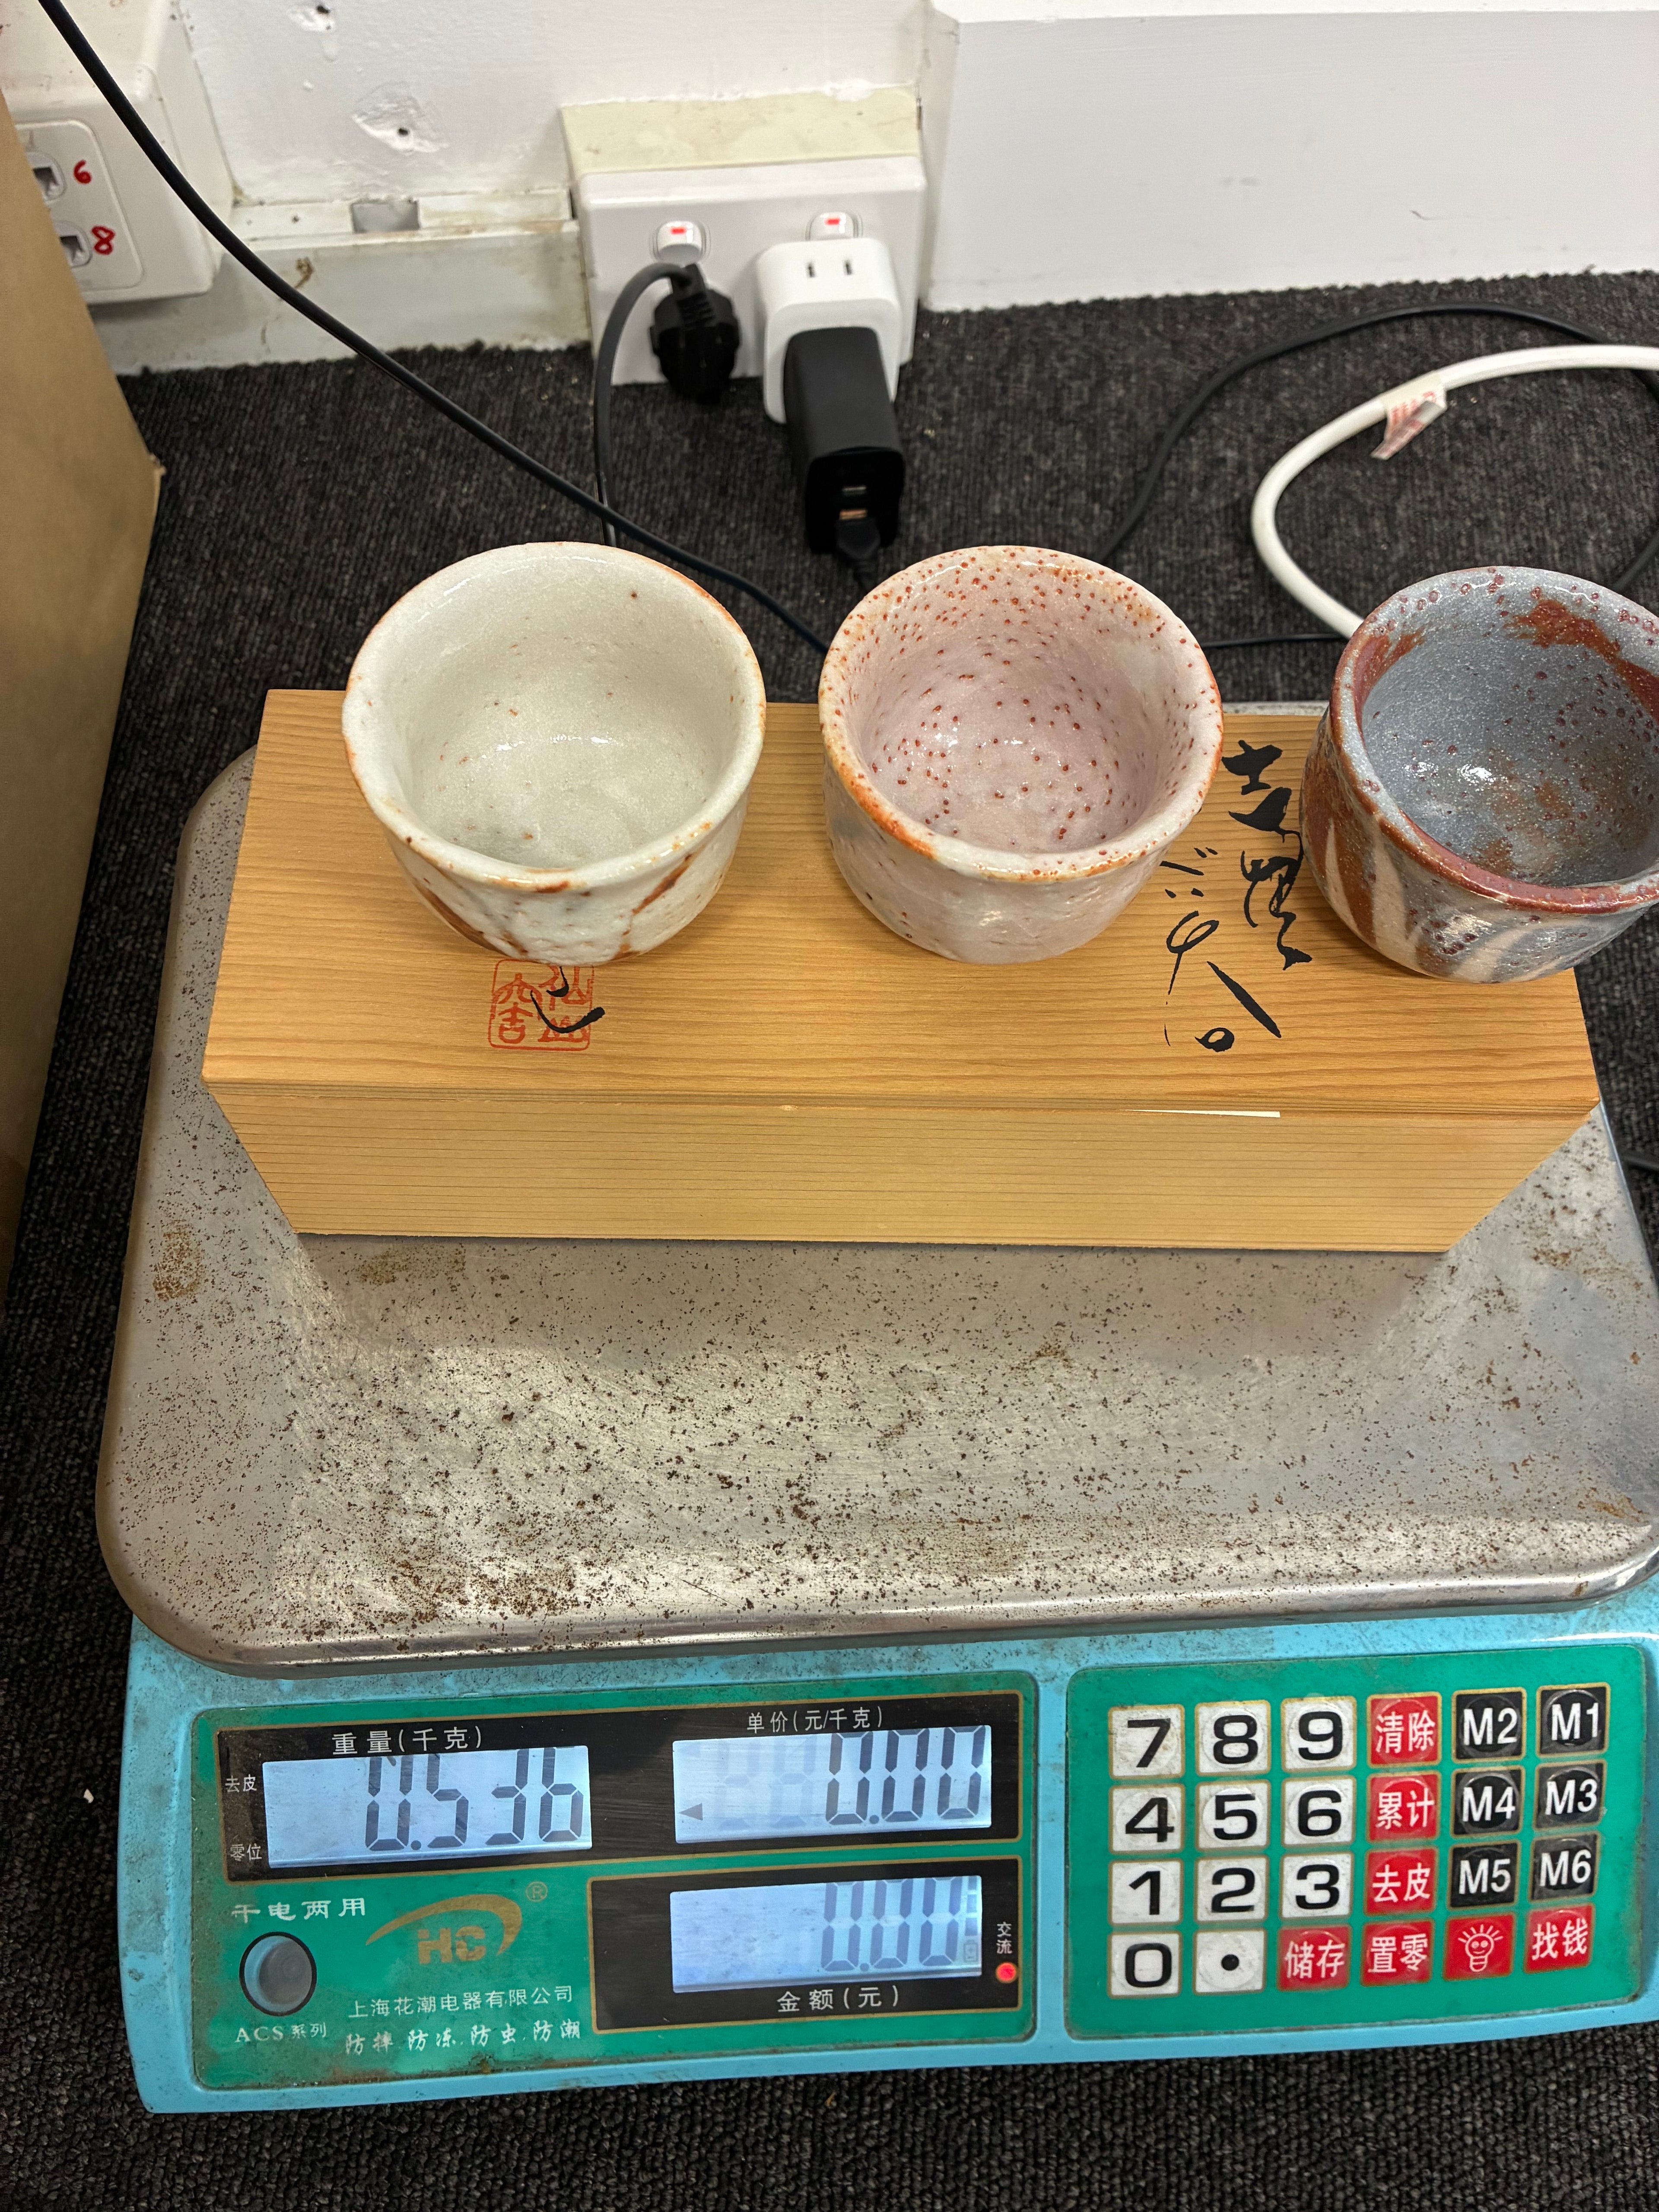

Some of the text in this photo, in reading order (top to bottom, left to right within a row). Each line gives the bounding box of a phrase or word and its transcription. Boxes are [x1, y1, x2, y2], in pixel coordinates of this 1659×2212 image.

[73, 159, 92, 184] 6
[91, 225, 116, 255] 8
[747, 1706, 883, 1734] 单价(元/千克)
[1213, 1715, 1258, 1764] 8
[1298, 1711, 1343, 1761] 9
[1375, 1710, 1436, 1754] 清除
[1463, 1708, 1518, 1746] M2
[1551, 1703, 1599, 1741] M1
[332, 1726, 481, 1756] 重量(千克)
[1127, 1718, 1171, 1768] 7
[225, 1774, 257, 1793] 去皮
[365, 1747, 584, 1852] 0.536
[1545, 1779, 1598, 1815] M3
[1125, 1797, 1174, 1842] 4
[1213, 1794, 1257, 1840] 5
[1297, 1790, 1342, 1837] 6
[1376, 1788, 1434, 1830] 累计
[1462, 1786, 1516, 1822] M4
[229, 1844, 262, 1861] 零位
[1539, 1850, 1592, 1887] M6
[1128, 1871, 1161, 1916] 1
[1211, 1867, 1255, 1913] 2
[1296, 1864, 1340, 1910] 3
[1373, 1863, 1431, 1903] 去皮
[1459, 1859, 1511, 1894] M5
[996, 1922, 1013, 1955] 交流
[1368, 1933, 1428, 1974] 置零
[1532, 1918, 1588, 1961] 找钱
[1125, 1943, 1172, 1987] 0
[1284, 1939, 1345, 1979] 储存
[348, 1985, 572, 2018] 上海花潮电器有限公司
[777, 1985, 899, 2012] 金额(元)
[235, 2021, 327, 2043] ACS 系列
